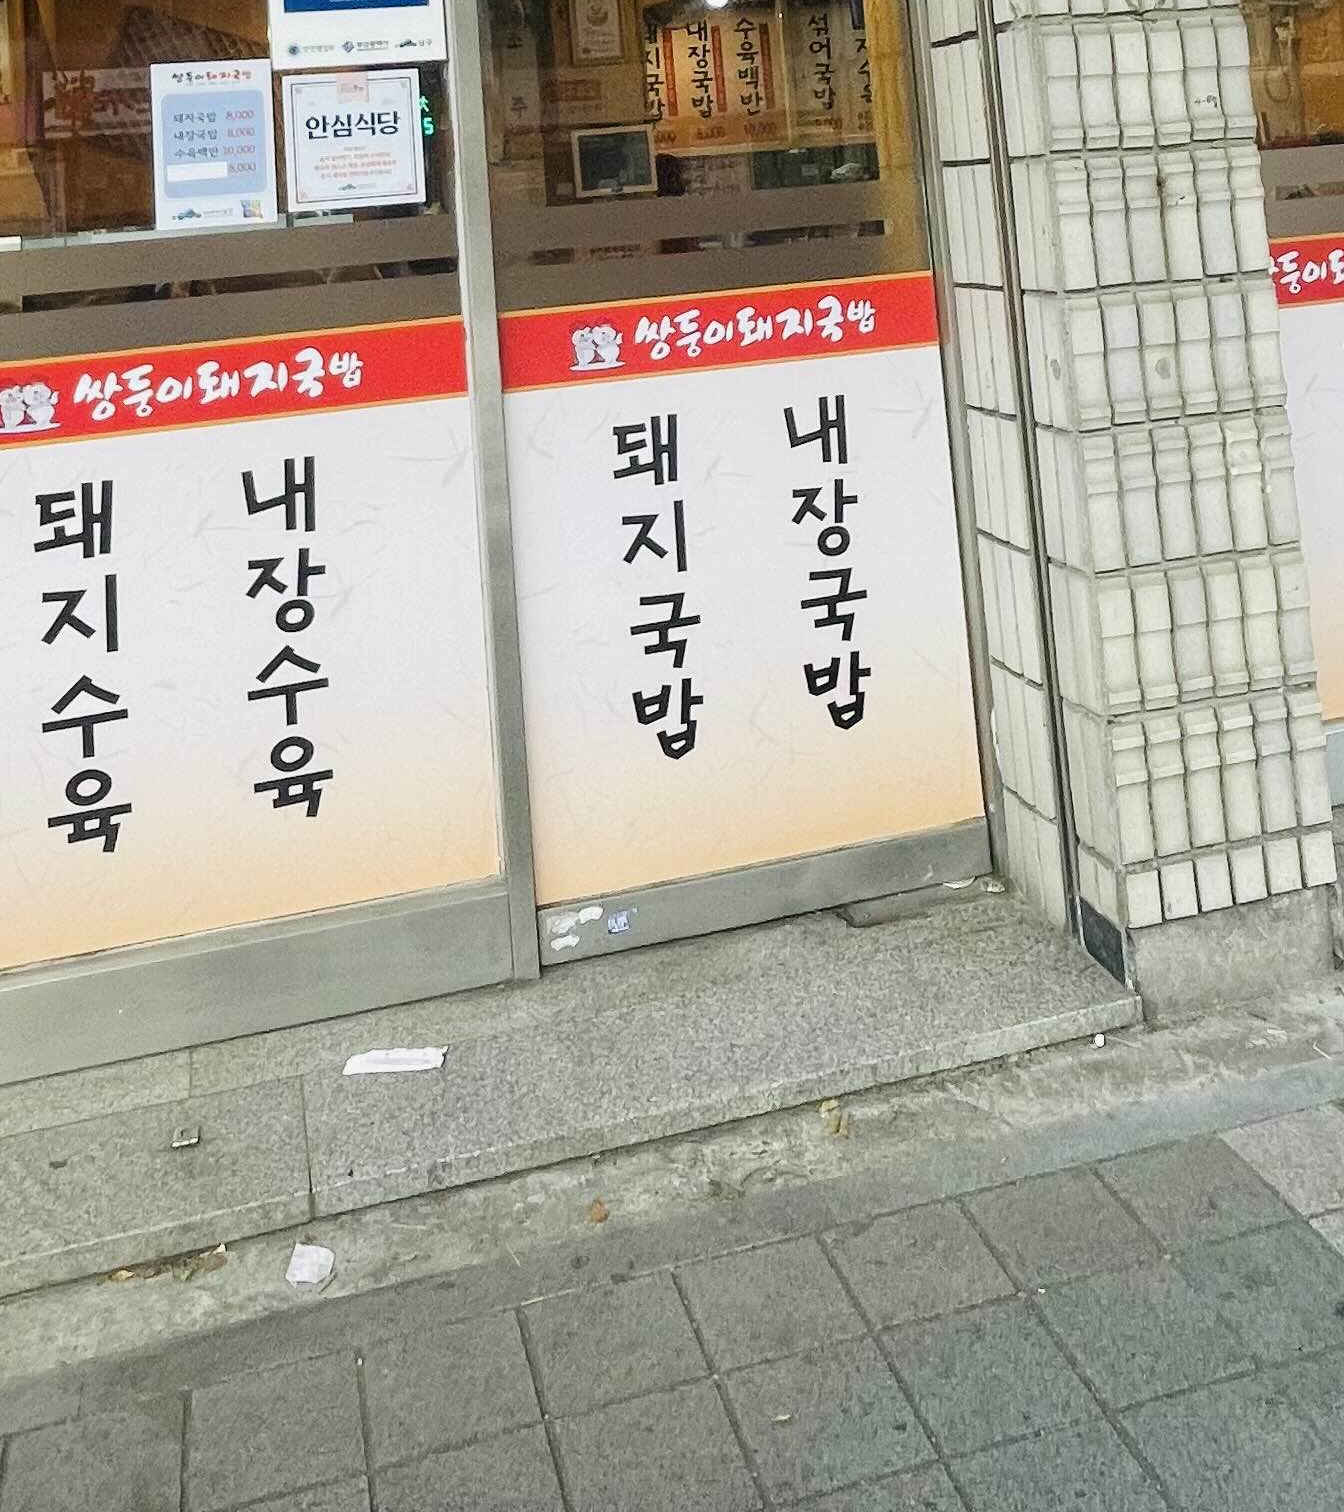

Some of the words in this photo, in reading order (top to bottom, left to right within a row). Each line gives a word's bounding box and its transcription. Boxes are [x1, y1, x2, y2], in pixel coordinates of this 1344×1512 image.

[305, 110, 401, 140] 안심식당
[686, 20, 715, 119] 내장국밥
[733, 17, 765, 117] 수육백반
[34, 480, 132, 853] 돼지수육
[242, 456, 334, 818] 내장수육
[613, 414, 704, 760] 돼지국밥
[784, 394, 872, 730] 내장국밥
